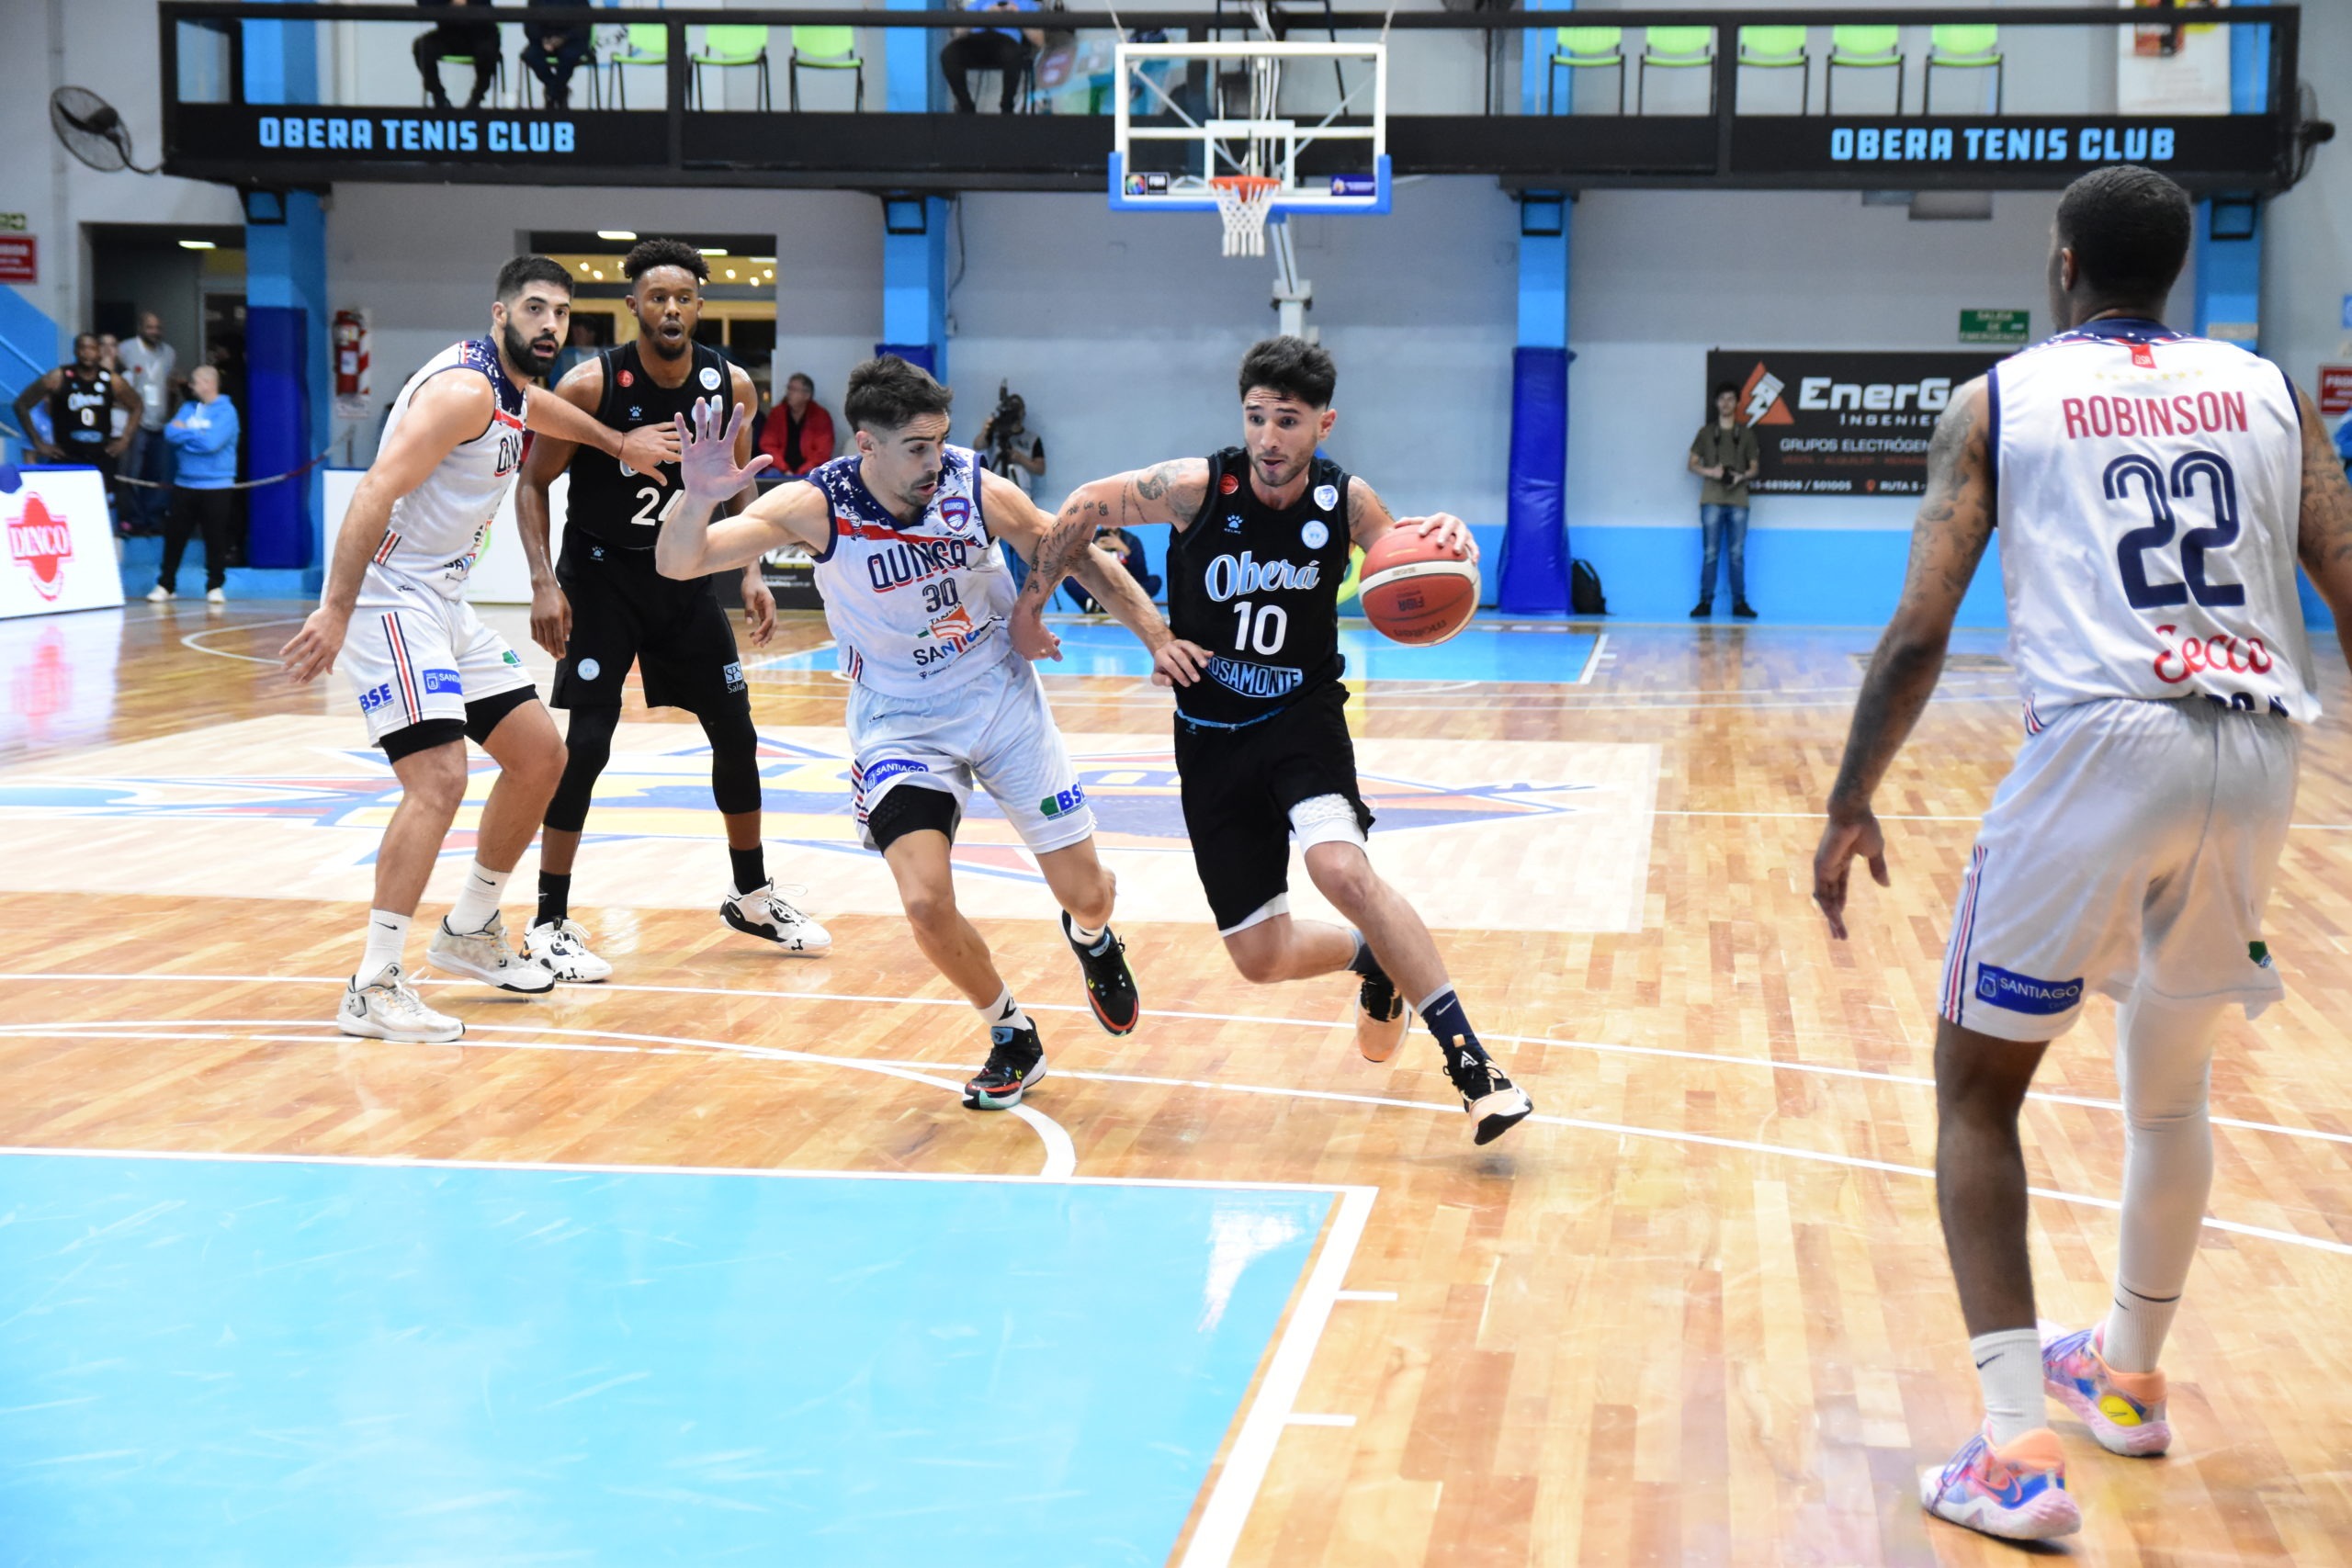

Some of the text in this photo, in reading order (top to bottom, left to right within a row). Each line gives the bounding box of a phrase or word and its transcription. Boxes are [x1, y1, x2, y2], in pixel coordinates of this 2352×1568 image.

[259, 117, 574, 152] OBERA TENIS CLUB
[1831, 128, 2175, 161] OBERA TENIS CLUB
[1798, 377, 1962, 411] EnerG
[2063, 390, 2249, 440] ROBINSON
[1780, 437, 1838, 453] GRUPOS
[1880, 479, 1909, 491] RUTA
[10, 525, 69, 557] DINCO
[2102, 450, 2245, 610] 22
[1205, 550, 1320, 603] Oberá
[922, 577, 959, 614] 30
[1233, 601, 1287, 656] 10
[2154, 625, 2273, 684] Secco
[358, 683, 392, 713] BSE
[876, 763, 927, 777] SANTIAGO
[1057, 781, 1085, 811] BS
[2000, 977, 2079, 999] SANTIAGO
